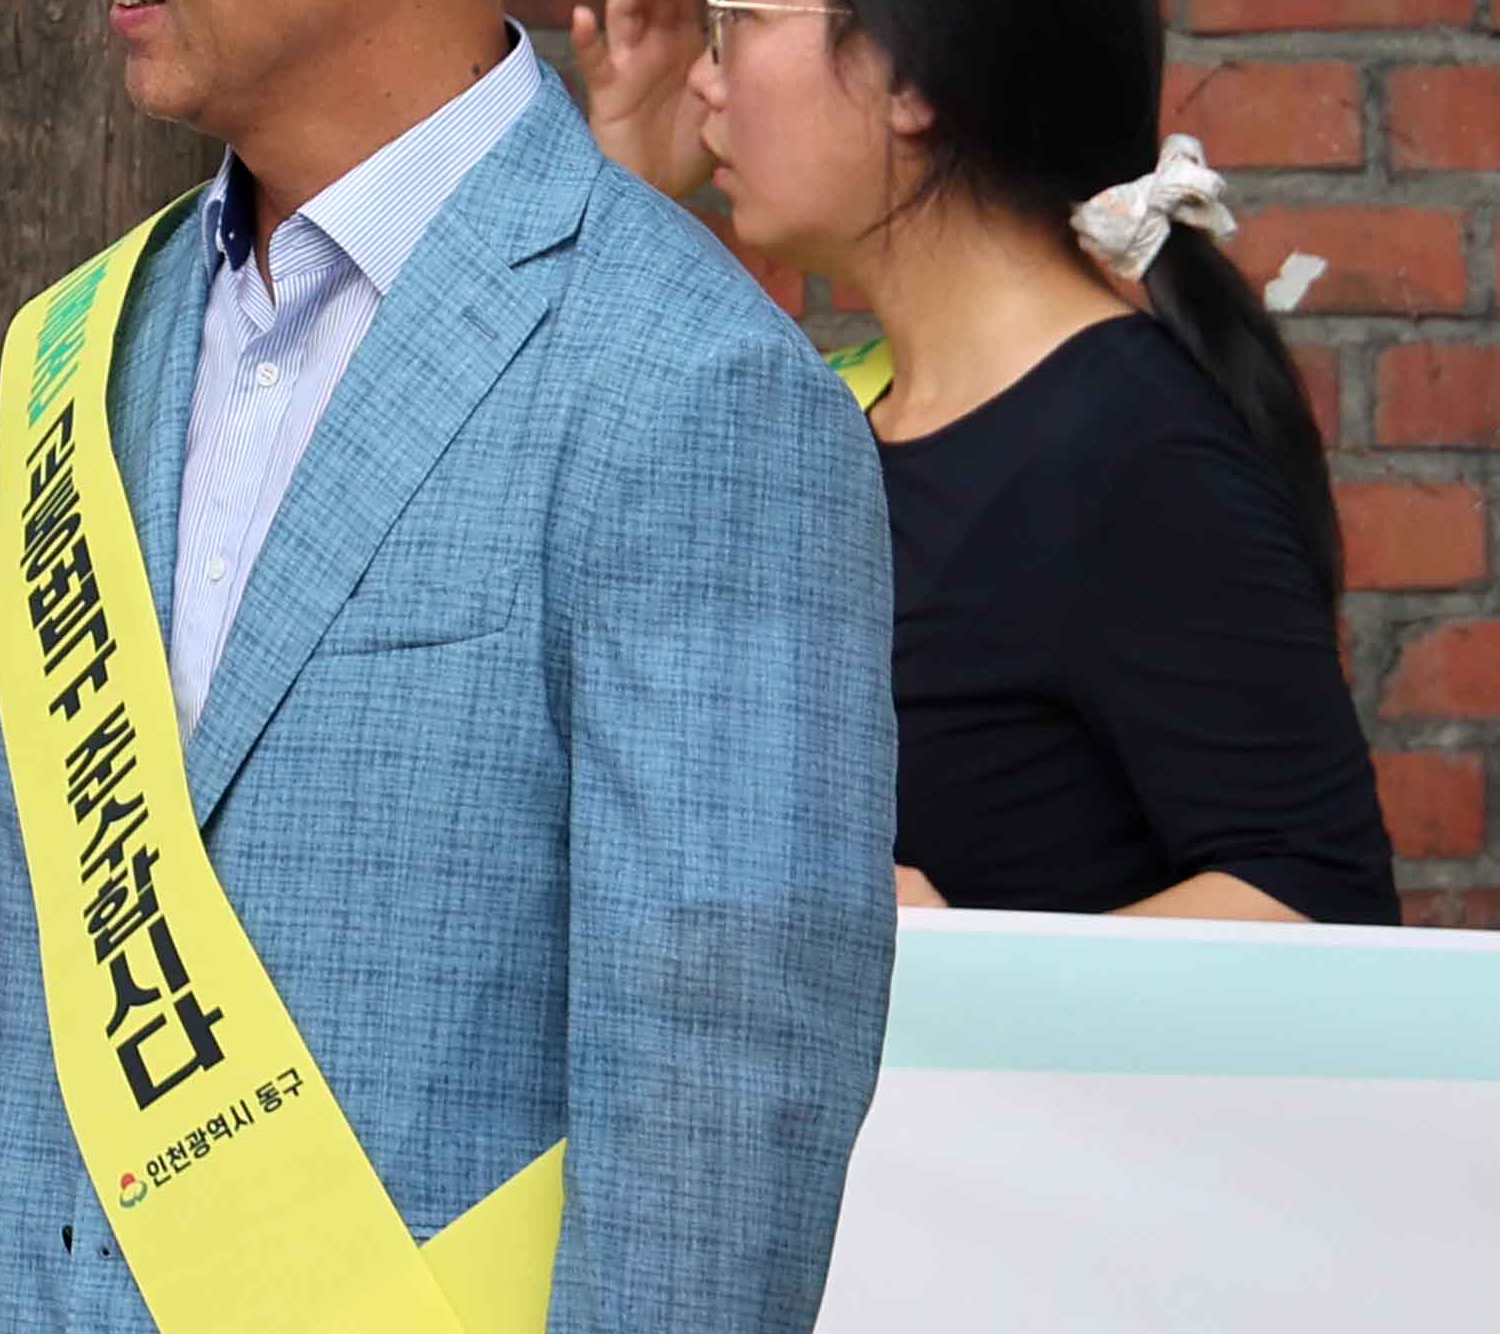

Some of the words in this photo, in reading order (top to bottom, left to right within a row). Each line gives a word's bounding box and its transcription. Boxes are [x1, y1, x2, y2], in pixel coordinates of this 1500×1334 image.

[18, 395, 120, 727] 교통법규
[64, 701, 227, 1114] 준수합시다
[146, 1098, 256, 1188] 인천광역시
[255, 1067, 304, 1114] 동구
